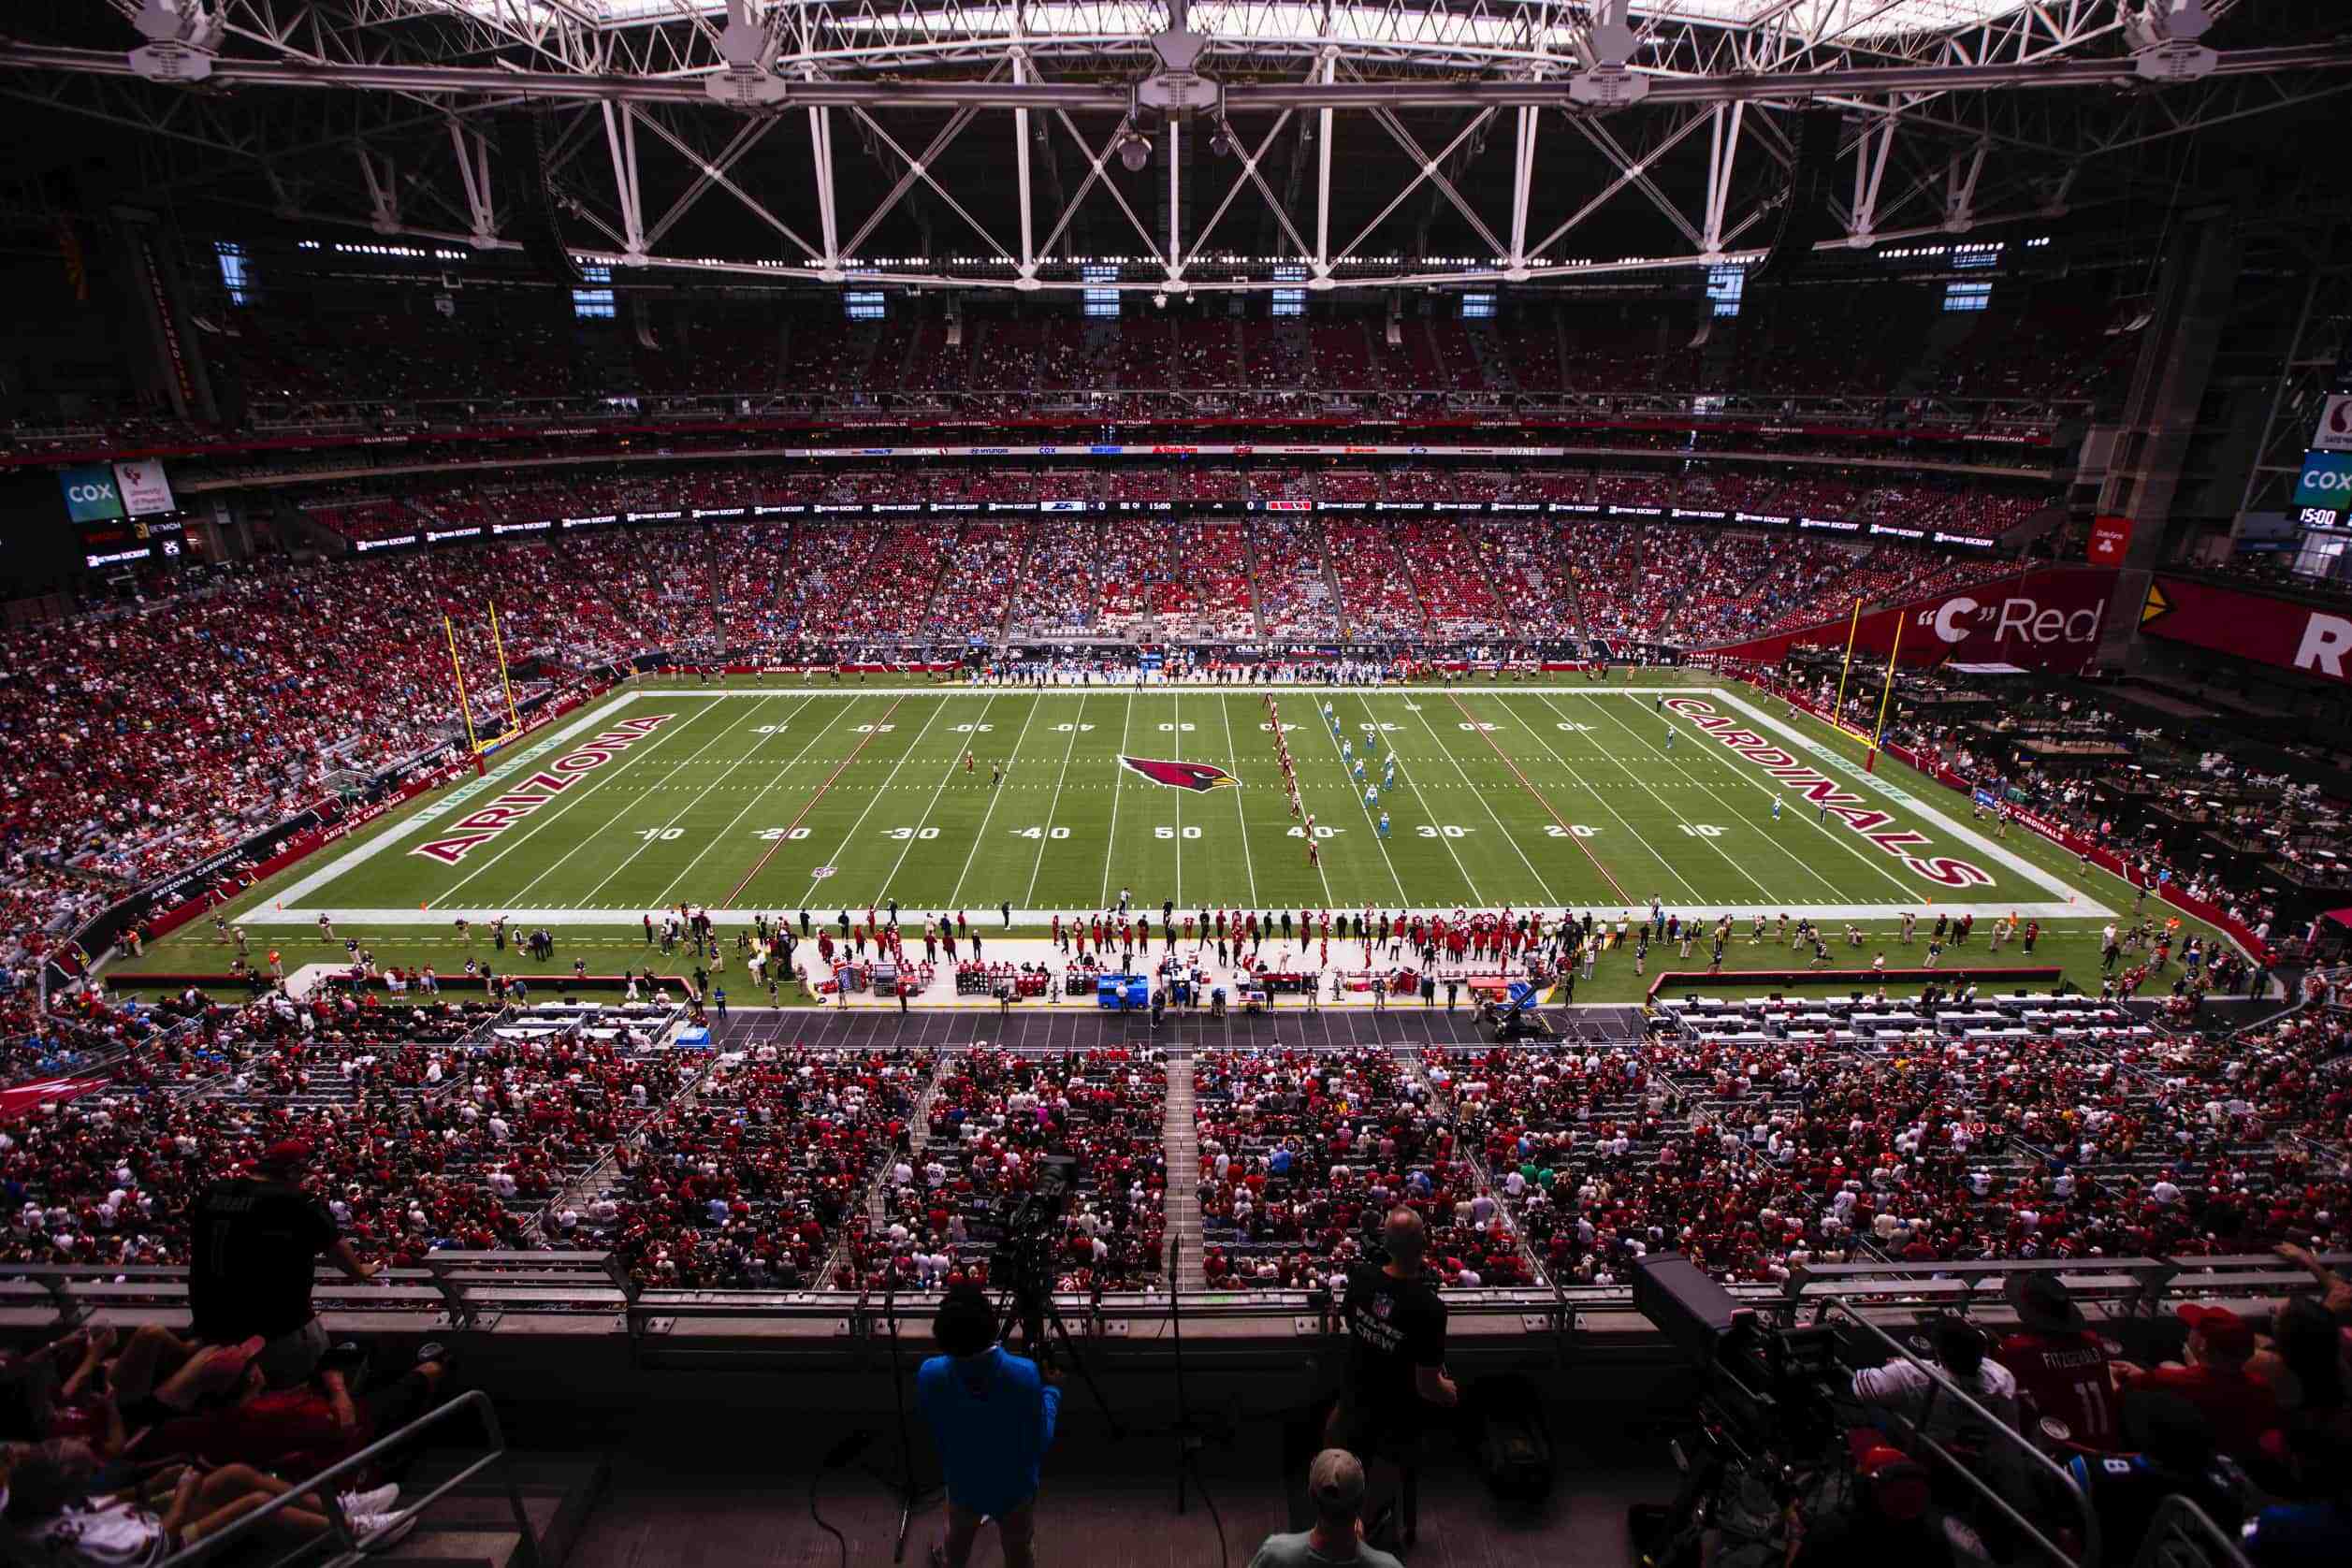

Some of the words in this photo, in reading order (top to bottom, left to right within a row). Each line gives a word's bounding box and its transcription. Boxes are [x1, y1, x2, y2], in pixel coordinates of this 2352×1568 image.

[2303, 471, 2352, 491] COX
[68, 484, 113, 503] COX
[1098, 502, 1105, 510] 0
[1149, 502, 1171, 510] 15:00
[1247, 501, 1254, 510] 0
[2299, 508, 2337, 525] 15:00
[163, 541, 180, 556] 25
[1994, 598, 2105, 643] Red
[407, 713, 677, 866] ARIZONA
[1663, 697, 1997, 888] CARDINALS
[1155, 827, 1202, 839] 50
[1416, 826, 1466, 838] 30
[1542, 825, 1595, 838] 20
[1677, 824, 1720, 837] 10
[2014, 811, 2064, 841] CARDINALS
[645, 827, 685, 840] 10
[759, 827, 813, 840] 20
[889, 828, 940, 839] 30
[1020, 828, 1071, 839] 40
[151, 874, 194, 900] ARIZONA
[196, 849, 244, 876] CARDINALS
[1500, 1243, 1510, 1252] 13
[2073, 1381, 2108, 1434] 11
